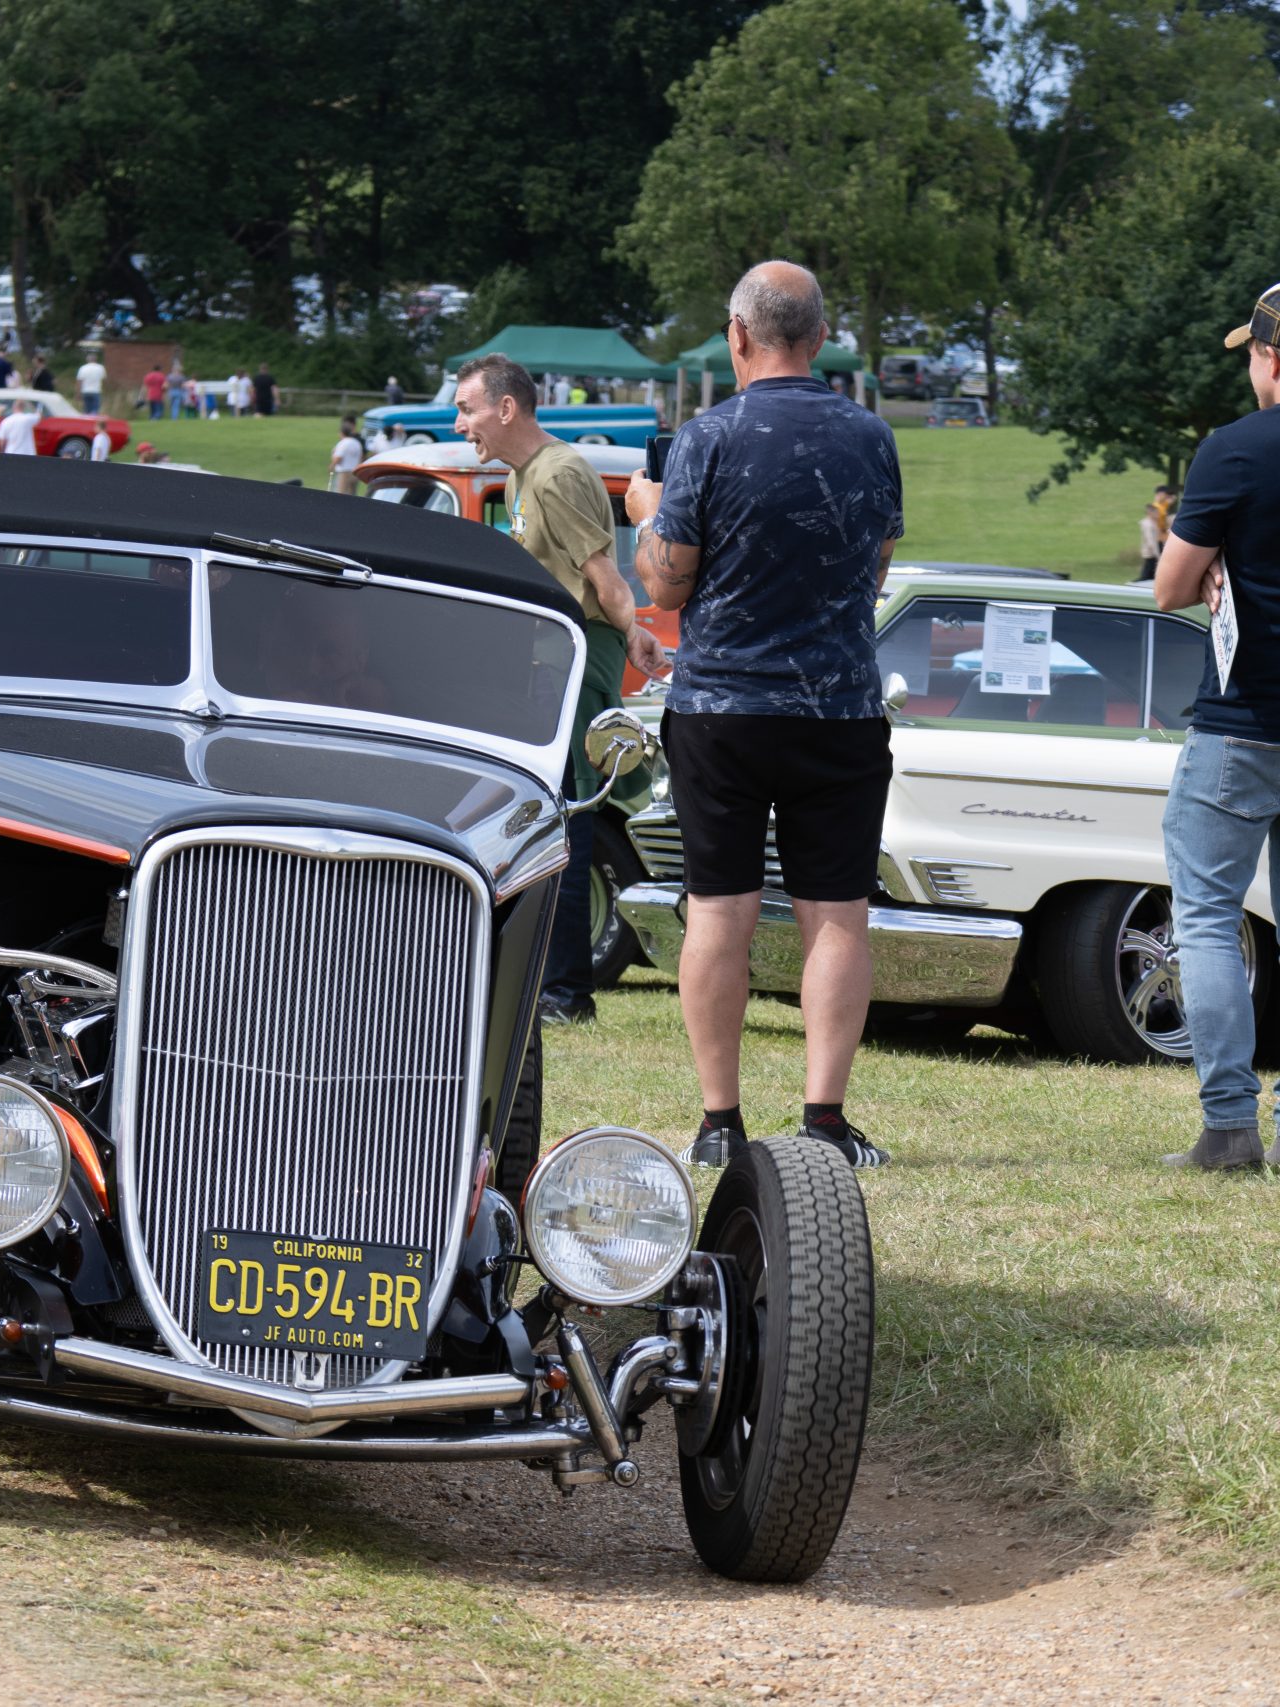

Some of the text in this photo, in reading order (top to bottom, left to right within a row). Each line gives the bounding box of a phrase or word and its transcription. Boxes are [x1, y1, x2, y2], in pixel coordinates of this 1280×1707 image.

[961, 803, 1097, 822] Commuter
[212, 1234, 228, 1249] 19
[273, 1240, 362, 1262] CALIFORNIA
[406, 1252, 423, 1269] 32
[209, 1258, 421, 1330] CD-594-BR
[264, 1325, 364, 1349] JF AUTO.COM
